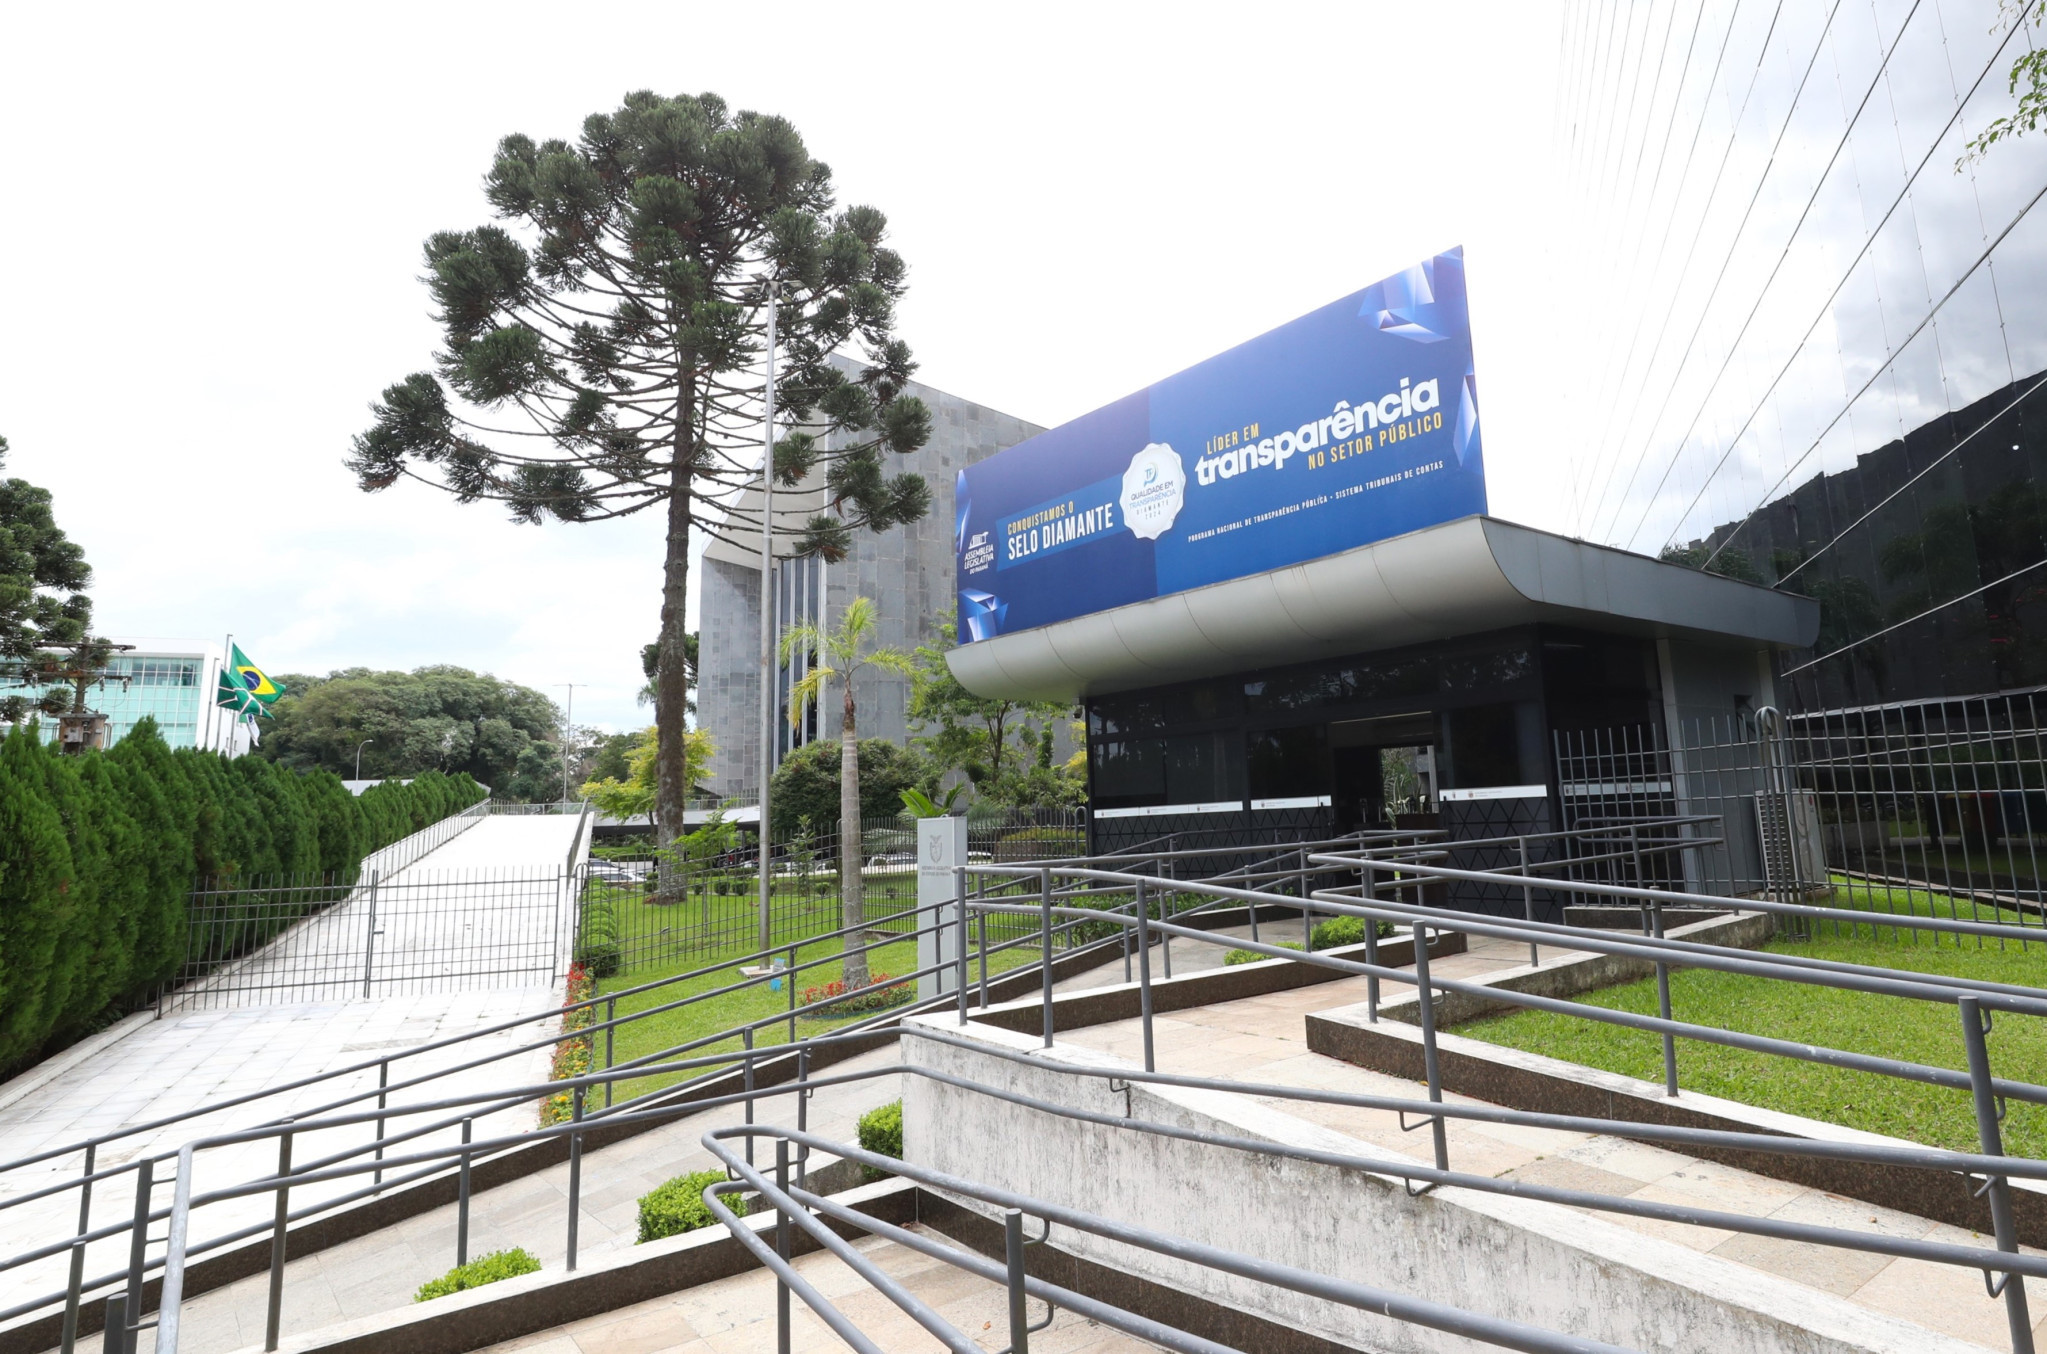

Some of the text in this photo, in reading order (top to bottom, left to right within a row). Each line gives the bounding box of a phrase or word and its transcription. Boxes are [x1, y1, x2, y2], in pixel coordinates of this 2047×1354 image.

[1195, 377, 1440, 486] transparência
[1207, 422, 1259, 455] LÍDER EM
[1308, 412, 1442, 471] NO SETOR PÚBLICO
[1129, 488, 1176, 508] TRANSPARÊNCIA
[1130, 480, 1173, 501] QUALIDADE EM
[1188, 528, 1215, 543] PROGRAMA
[1216, 520, 1243, 535] NACIONAL
[1244, 517, 1252, 527] DE
[1253, 503, 1300, 524] TRANSPARÊNCIA
[1335, 484, 1363, 500] SISTEMA
[1365, 472, 1402, 491] TRIBUNAIS
[1404, 469, 1414, 479] DE
[1415, 460, 1444, 476] CONTAS
[1007, 500, 1074, 536] CONQUISTAMOS O
[1008, 502, 1114, 561] SELO DIAMANTE
[964, 552, 994, 570] LEGISLATIVA
